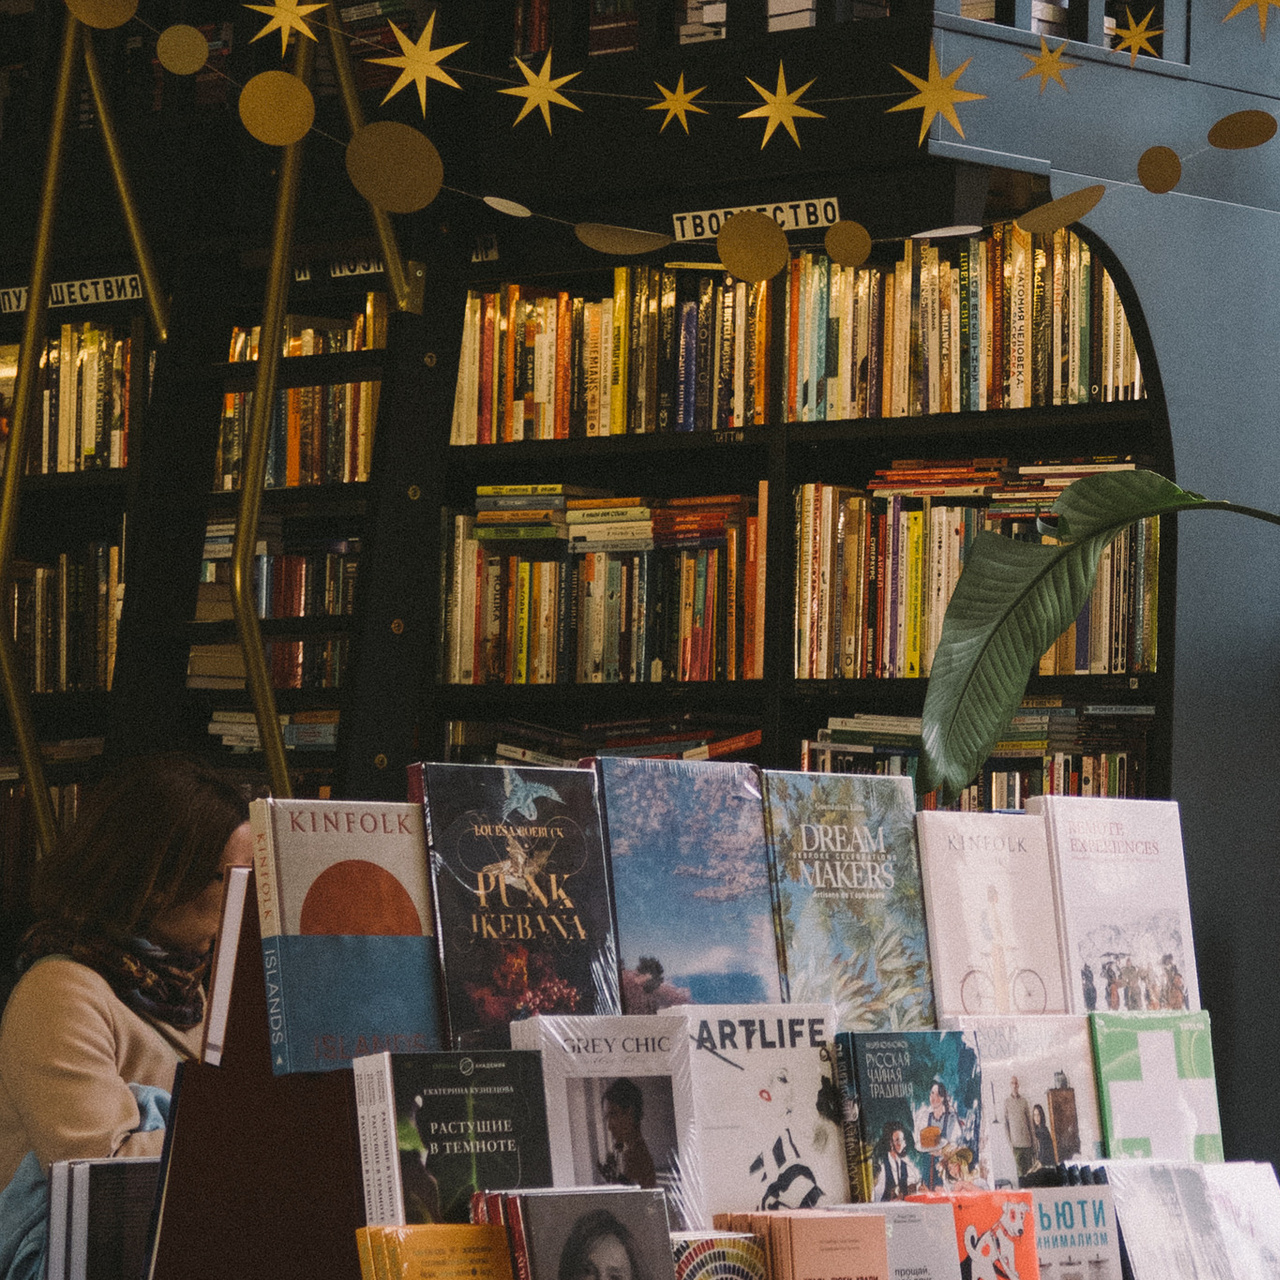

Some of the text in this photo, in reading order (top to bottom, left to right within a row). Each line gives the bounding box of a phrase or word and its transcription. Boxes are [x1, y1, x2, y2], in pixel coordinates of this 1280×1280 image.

[676, 202, 836, 238] ТВОСТВО
[2, 276, 142, 312] ПУШЕСТВИЯ
[1016, 263, 1025, 321] НАТОМИЯ
[289, 811, 413, 834] KINFOLK
[799, 824, 886, 853] DREAM
[947, 835, 1028, 853] KINFOLK
[1069, 838, 1160, 856] EXPERIENCES
[797, 860, 896, 889] MAKERS
[476, 872, 575, 909] PUNK
[257, 832, 285, 1046] KINFOLK ISLANDS
[471, 913, 587, 941] IKEBANA
[562, 1036, 671, 1054] GREY CHIC
[695, 1018, 827, 1051] ARTLIFE
[430, 1119, 513, 1135] РАСТУЩИЕ
[430, 1138, 517, 1154] В ТЕМНОТЕ
[1037, 1199, 1107, 1232] ЬЮТИ
